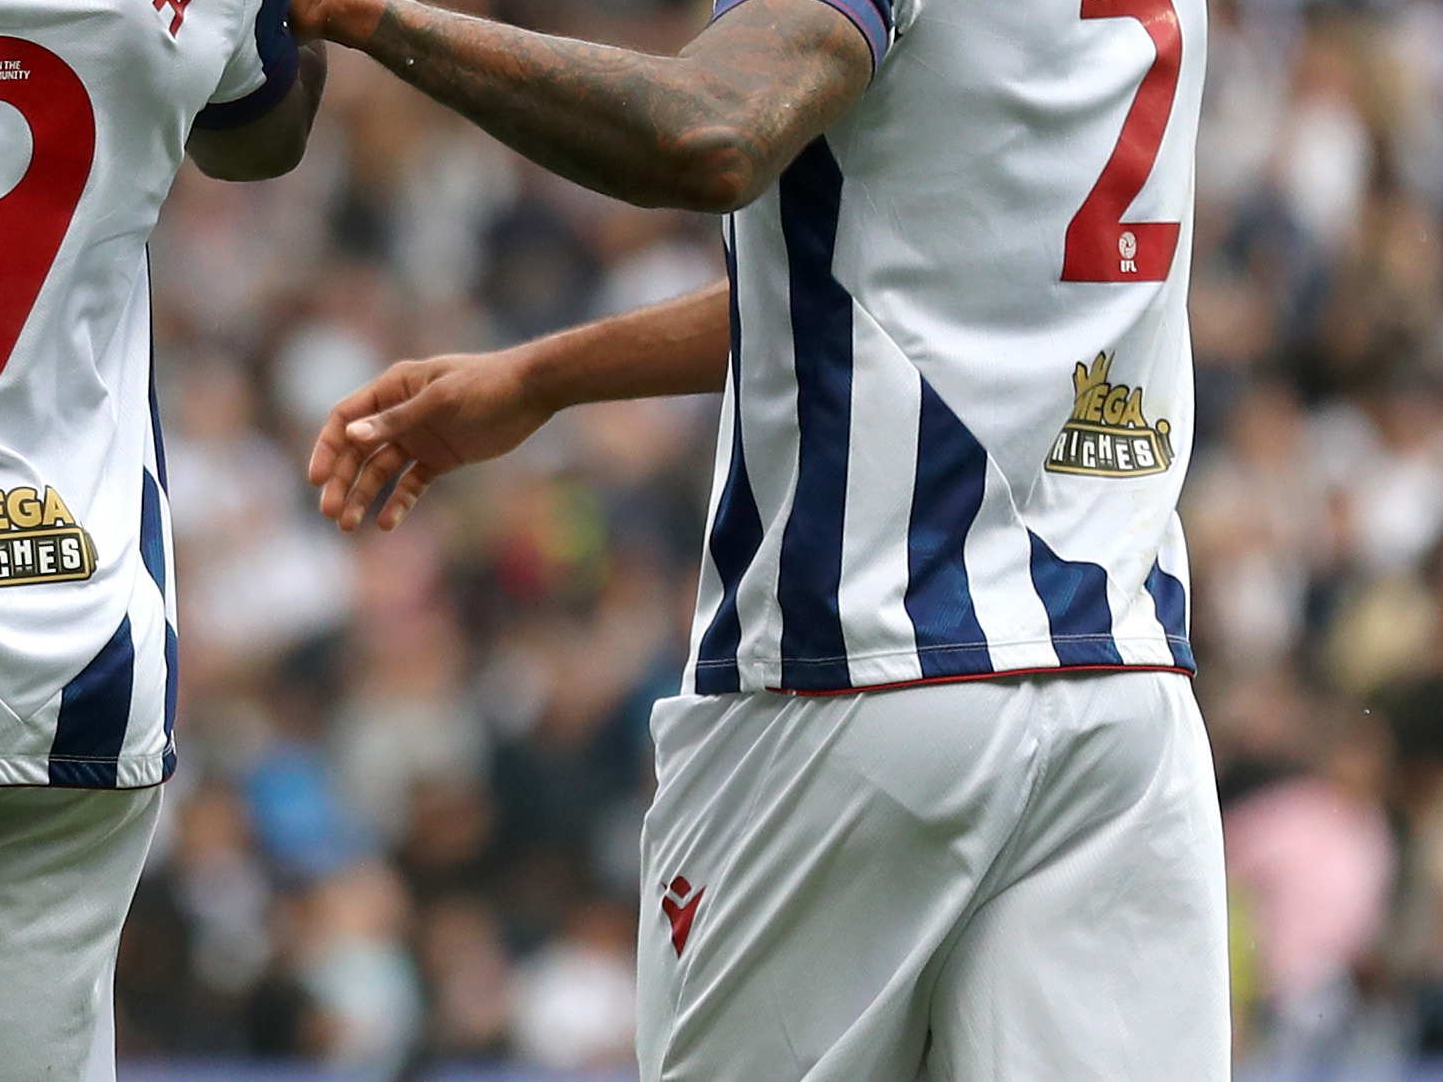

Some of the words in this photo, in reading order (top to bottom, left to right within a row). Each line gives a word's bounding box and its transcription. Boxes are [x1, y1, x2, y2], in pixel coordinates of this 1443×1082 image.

[4, 60, 22, 70] THE
[1120, 260, 1137, 273] EFL
[1071, 383, 1148, 428] MEGA
[1052, 431, 1155, 470] RICHES
